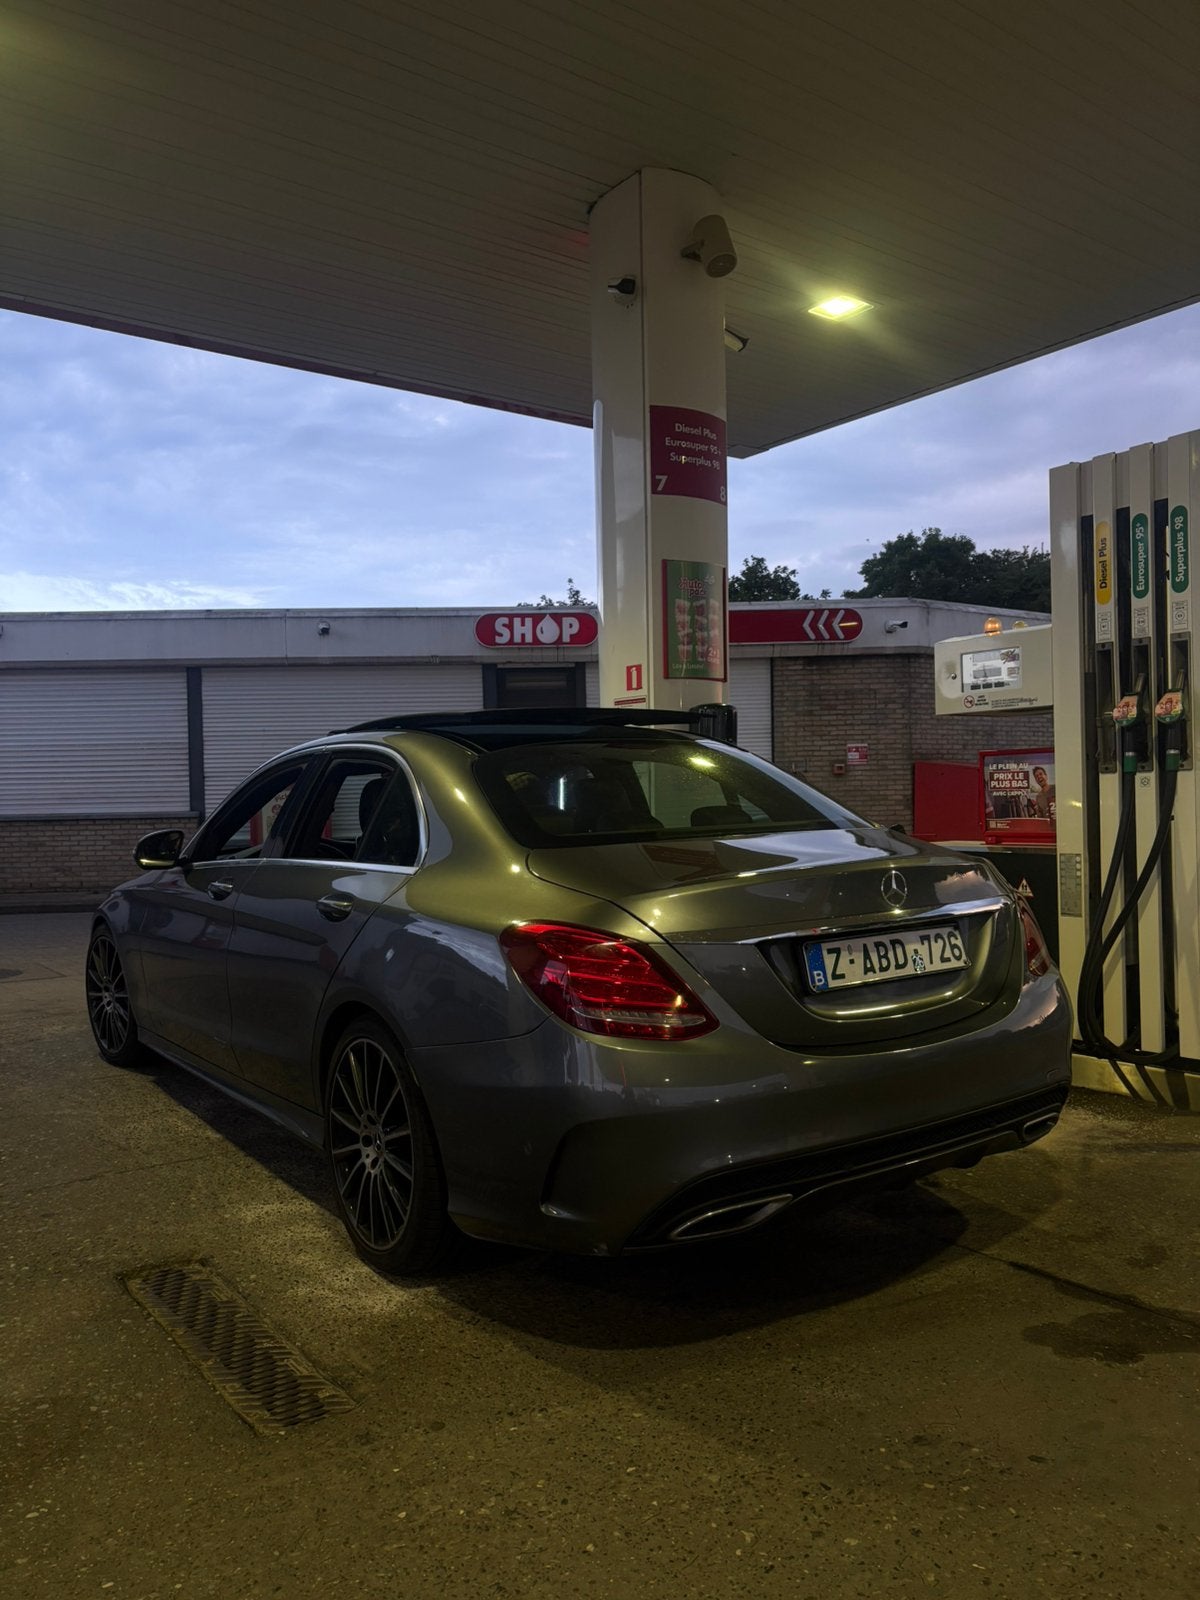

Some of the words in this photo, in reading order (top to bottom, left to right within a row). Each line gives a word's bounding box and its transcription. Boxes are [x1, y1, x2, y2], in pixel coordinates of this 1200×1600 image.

[675, 423, 701, 436] Diesel
[703, 428, 717, 440] Plus
[665, 437, 708, 452] Eurosuper
[670, 452, 711, 467] Superplus
[655, 475, 668, 491] 7
[1174, 516, 1184, 530] 98
[1099, 537, 1107, 558] Plus
[1175, 531, 1186, 582] Superplus
[1099, 559, 1107, 589] Diesel
[1136, 542, 1147, 591] Eurosuper
[494, 614, 580, 644] SHOP
[990, 780, 1010, 788] PLUS
[1014, 772, 1024, 780] LE
[814, 970, 825, 985] B
